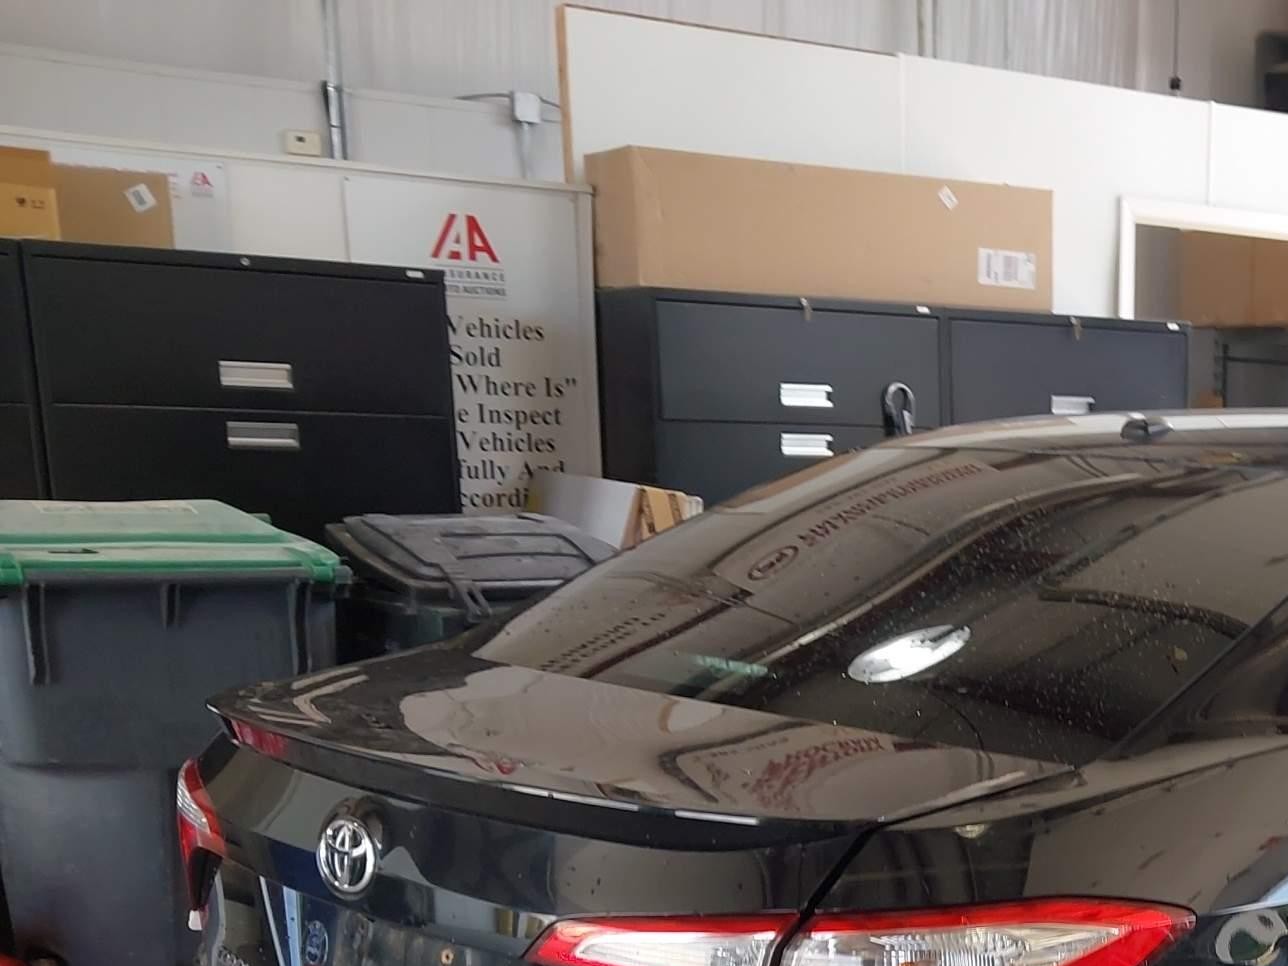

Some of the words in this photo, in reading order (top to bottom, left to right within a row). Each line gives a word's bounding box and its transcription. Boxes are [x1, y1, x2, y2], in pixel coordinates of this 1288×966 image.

[447, 315, 545, 341] Vehicles
[449, 344, 502, 368] Sold
[455, 373, 537, 397] Where
[543, 376, 577, 398] Is"
[477, 403, 562, 431] Inspect
[456, 430, 556, 453] Vehicles
